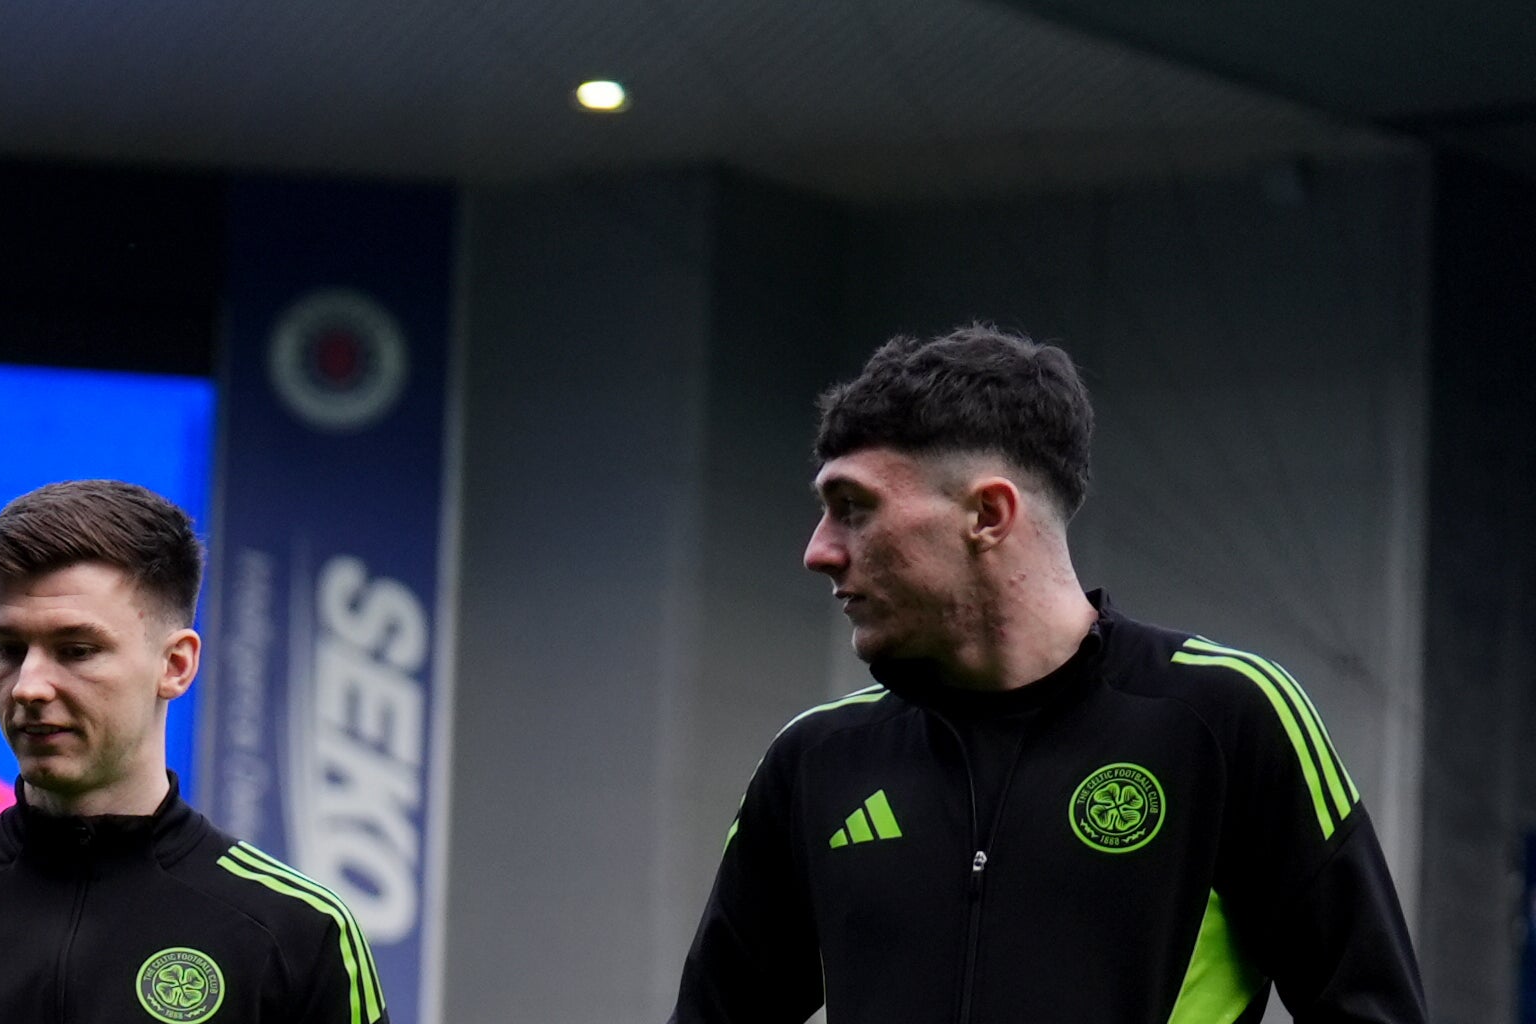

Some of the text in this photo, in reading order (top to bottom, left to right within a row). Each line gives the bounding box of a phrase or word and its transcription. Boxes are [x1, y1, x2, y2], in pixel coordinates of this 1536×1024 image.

[316, 554, 429, 946] SEKO
[1077, 768, 1159, 814] THE CELTIC FOOTBALL CLUB
[144, 952, 219, 994] THE CELTIC FOOTBALL CLUB
